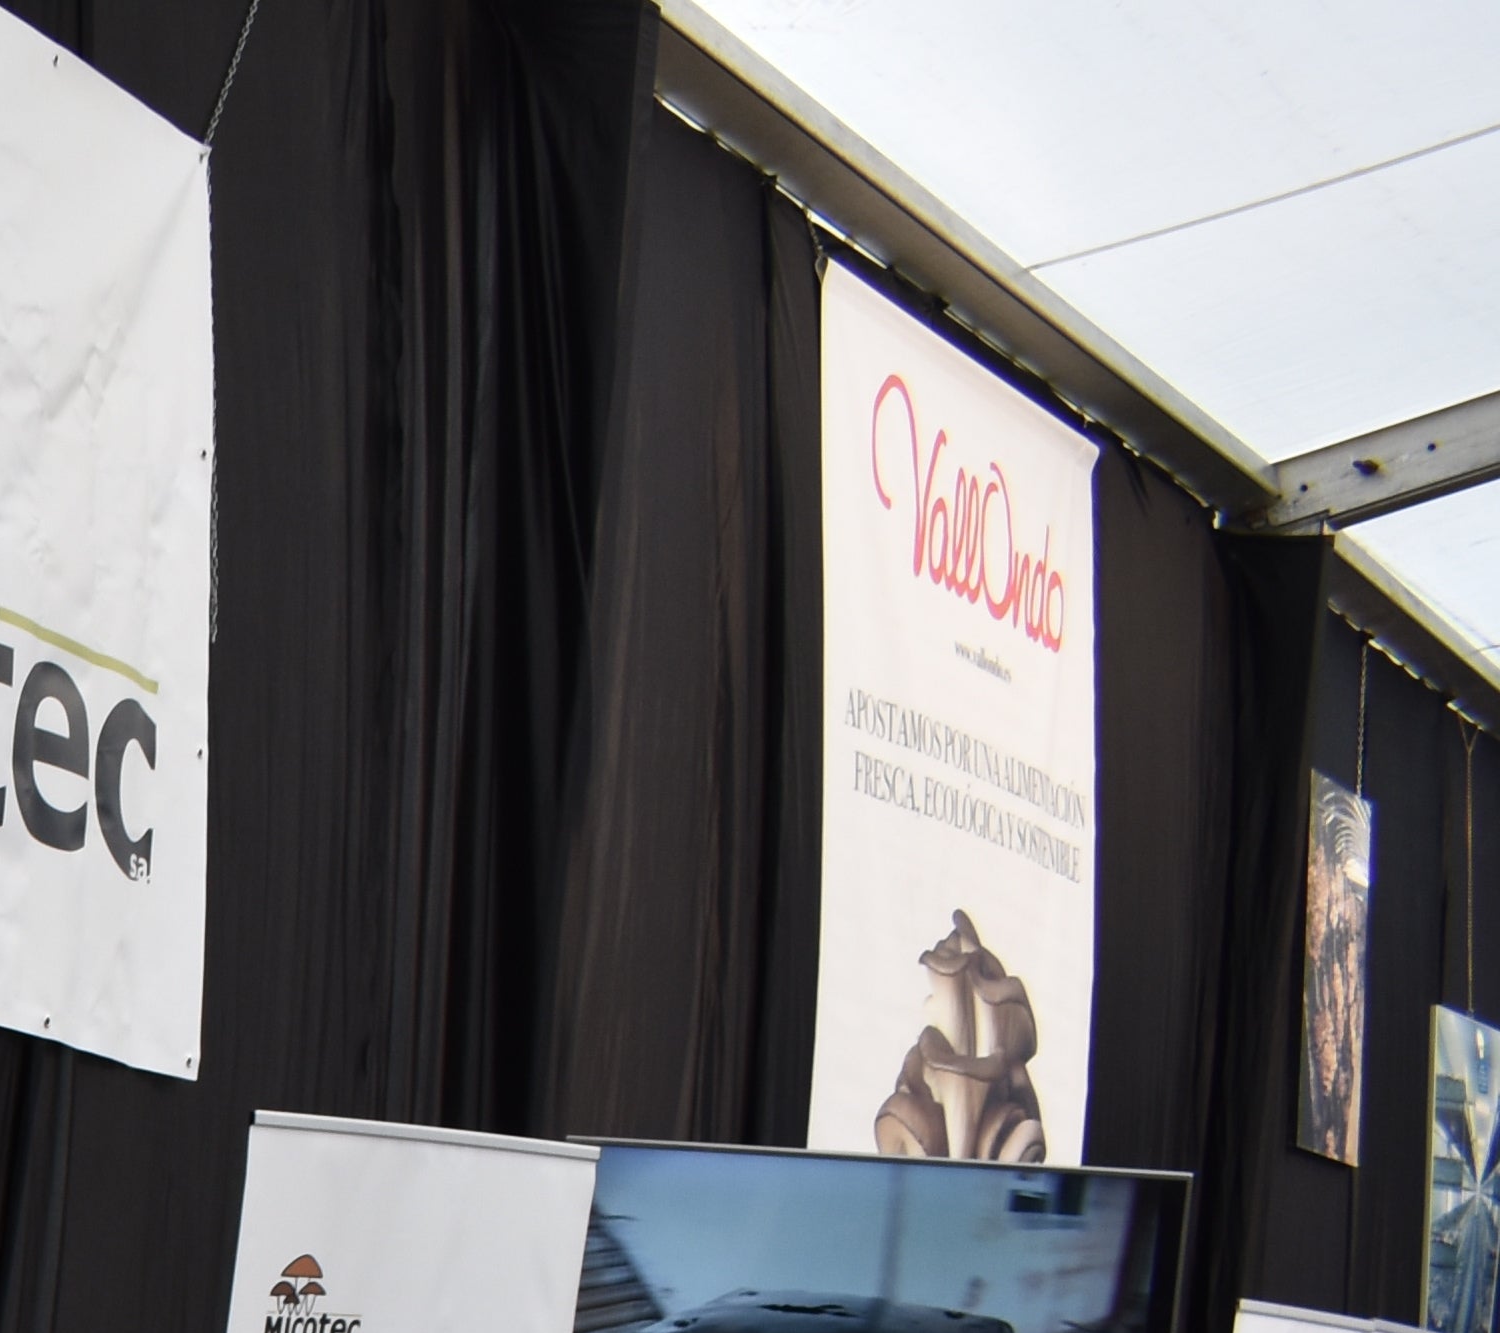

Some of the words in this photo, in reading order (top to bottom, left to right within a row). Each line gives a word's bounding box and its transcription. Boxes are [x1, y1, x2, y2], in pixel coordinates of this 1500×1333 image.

[844, 687, 942, 761] APOSTAMOS
[944, 725, 972, 774] POR
[973, 739, 1001, 788] UNA
[1000, 755, 1086, 829] ALIMENTACIÓN
[923, 776, 1005, 848] ECOLÓGICA
[1005, 811, 1016, 851] Y
[1016, 816, 1081, 884] SOSTENIBLE
